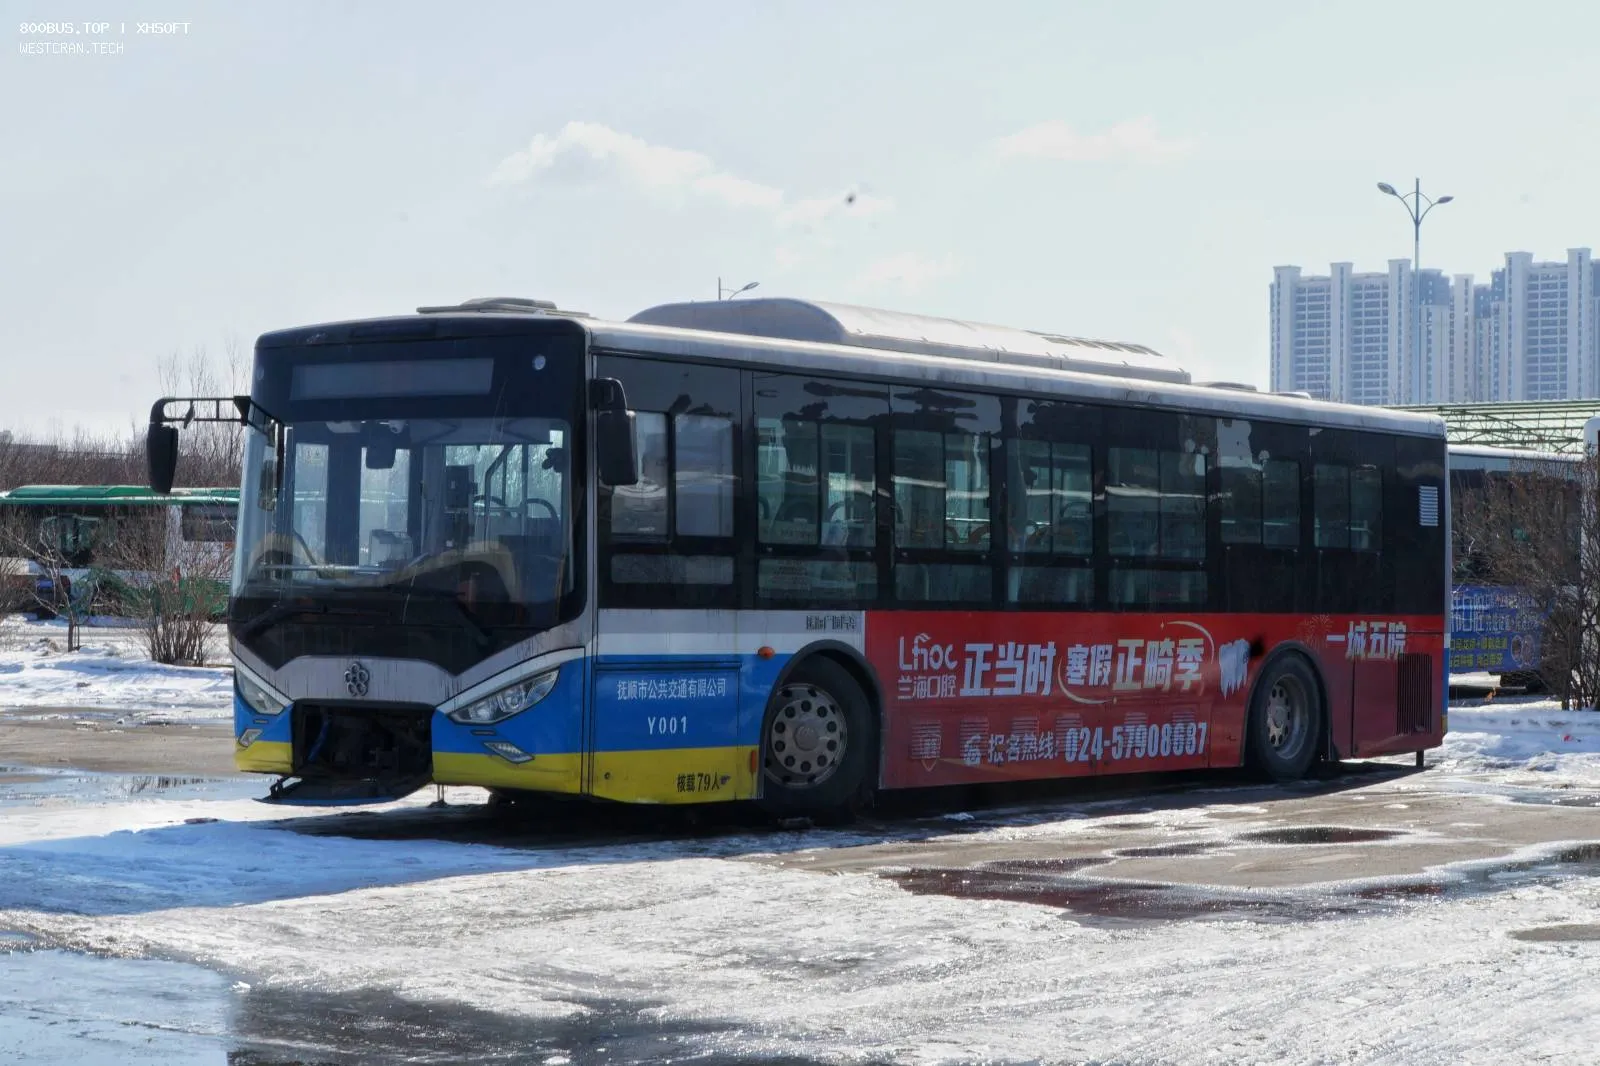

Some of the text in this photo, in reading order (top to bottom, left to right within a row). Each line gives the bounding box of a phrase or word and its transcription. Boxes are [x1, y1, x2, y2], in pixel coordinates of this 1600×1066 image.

[960, 641, 1057, 696] 正当时
[617, 677, 727, 701] 抚顺市公共交通有限公司
[897, 674, 957, 700] 兰海口腔
[648, 716, 688, 735] Y001
